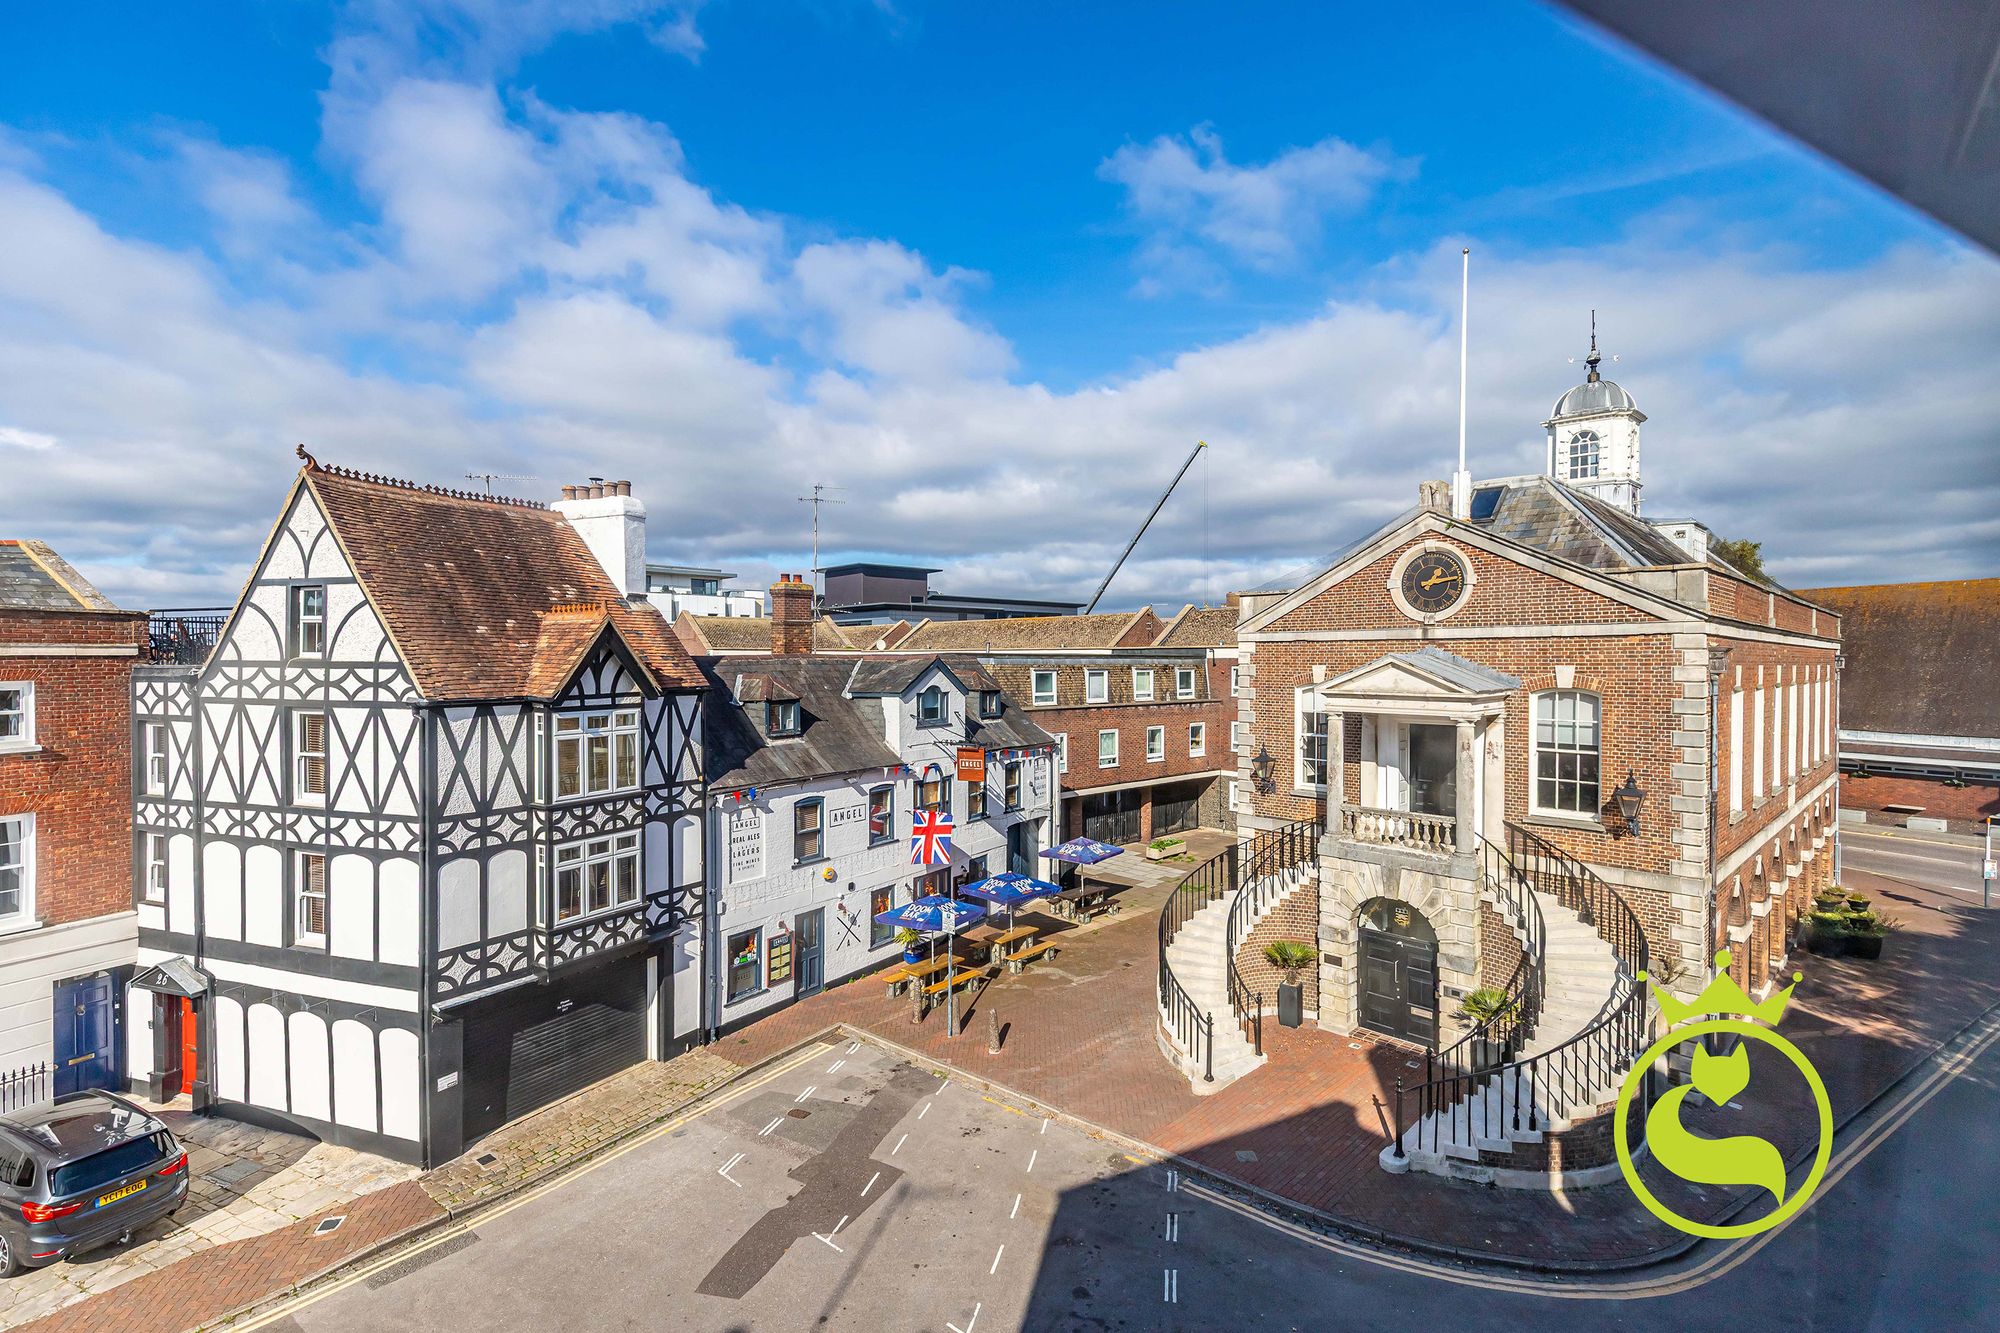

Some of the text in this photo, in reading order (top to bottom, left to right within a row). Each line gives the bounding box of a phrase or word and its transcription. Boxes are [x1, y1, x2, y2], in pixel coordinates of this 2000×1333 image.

[961, 760, 980, 768] ANGEL
[833, 808, 862, 823] ANGEL
[735, 820, 757, 829] ANGEL
[732, 833, 760, 844] REAL ALES
[733, 846, 760, 859] LAGERS
[746, 857, 760, 865] WINES
[908, 903, 935, 914] DOOM
[902, 910, 919, 919] BAR
[155, 973, 169, 986] 26
[103, 1181, 143, 1203] YC17 EOG
